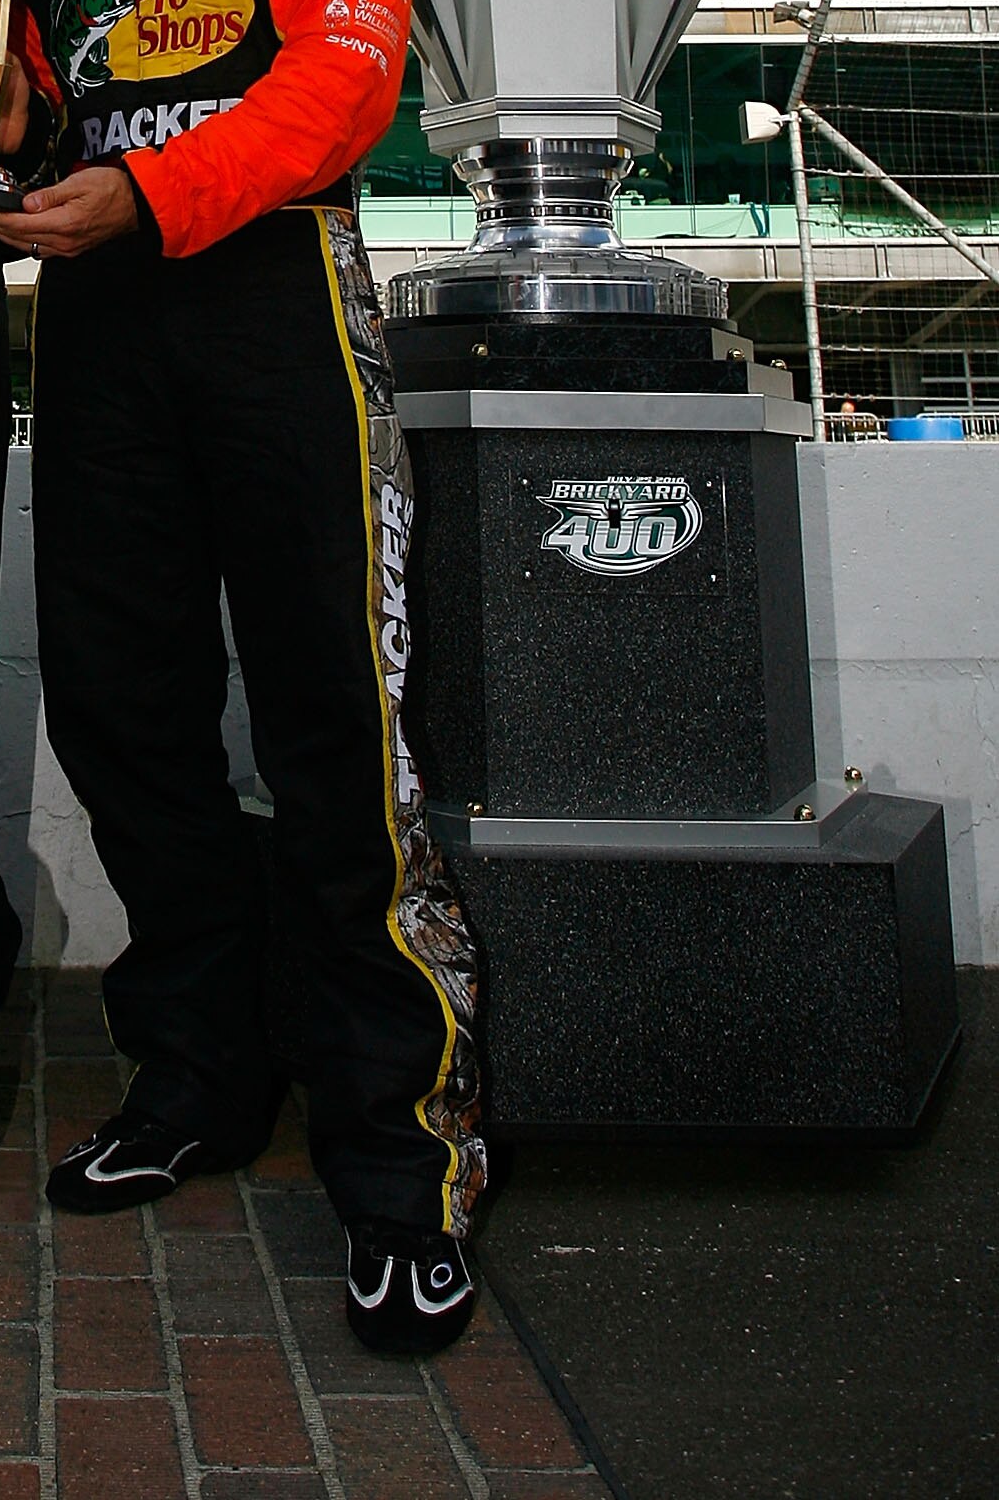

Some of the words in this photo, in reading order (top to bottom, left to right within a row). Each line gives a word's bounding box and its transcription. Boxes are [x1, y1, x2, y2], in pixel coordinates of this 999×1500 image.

[137, 10, 246, 57] Shops
[553, 484, 688, 501] BRICKYARD
[548, 515, 678, 559] 400
